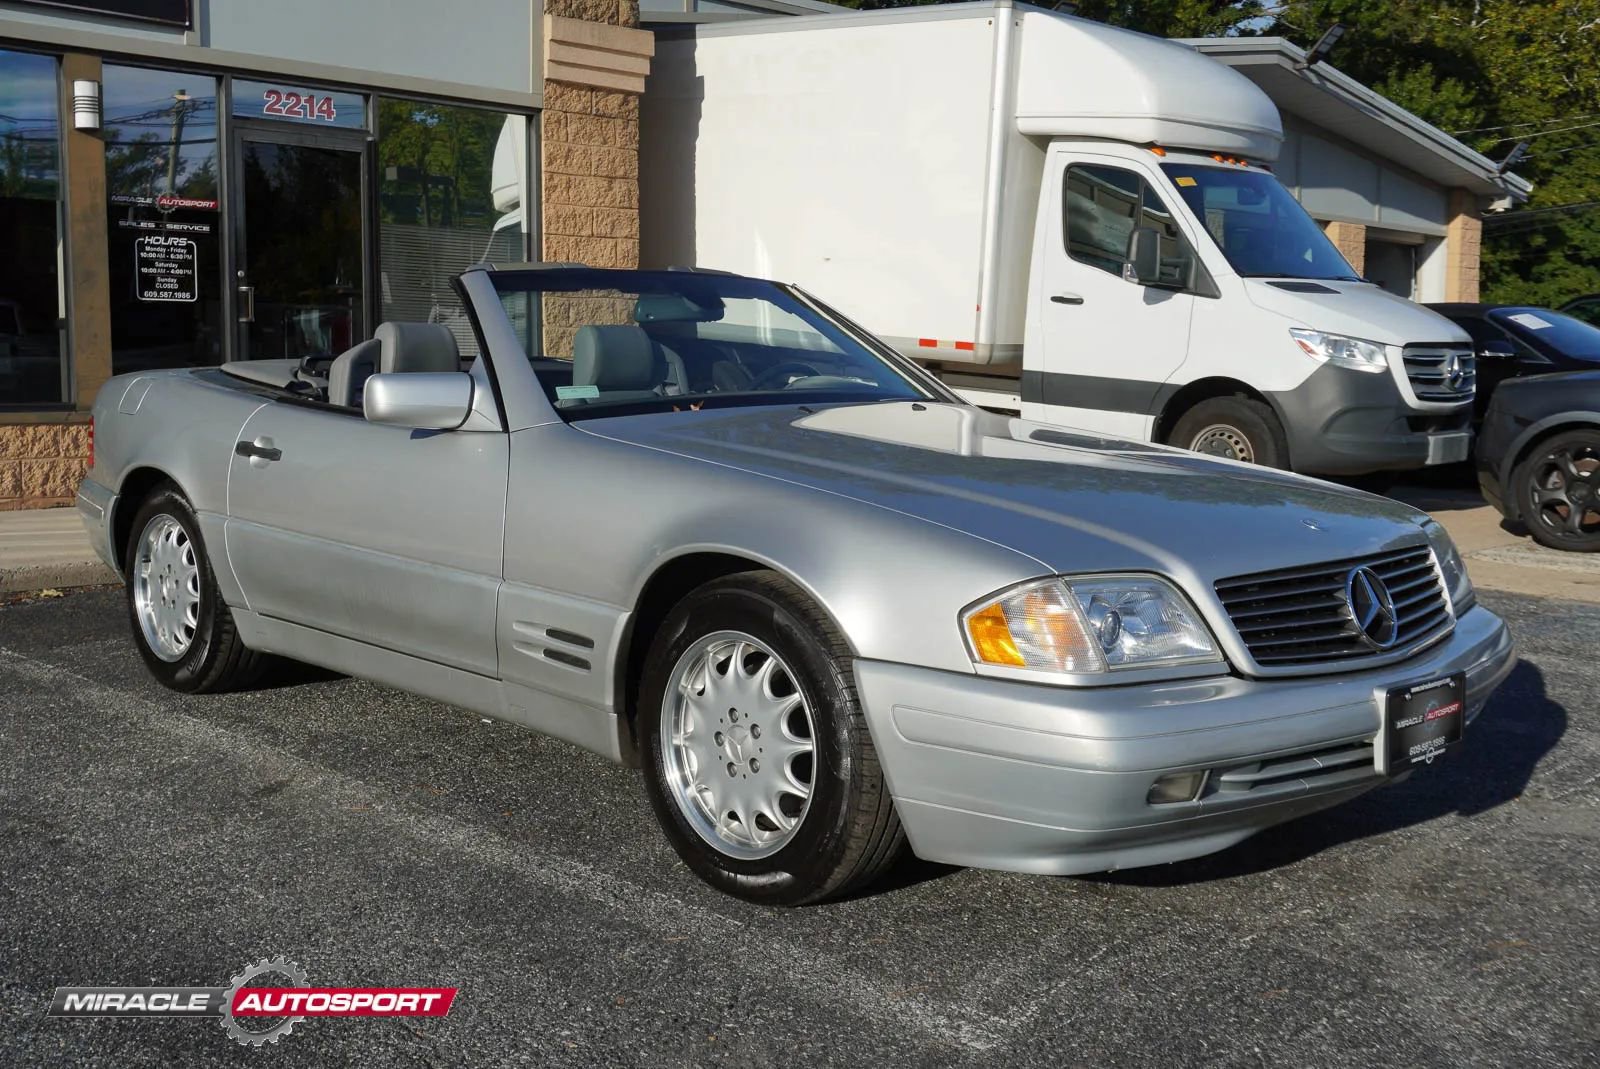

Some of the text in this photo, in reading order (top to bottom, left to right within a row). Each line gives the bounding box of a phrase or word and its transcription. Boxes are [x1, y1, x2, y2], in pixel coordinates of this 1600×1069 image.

[264, 89, 336, 121] 2214
[111, 195, 215, 208] MIRACLE AUTOSPORT
[119, 220, 210, 232] SALES SERVICE
[144, 236, 188, 246] HOURS
[144, 291, 190, 299] 609.587.1986
[1396, 703, 1459, 730] MIRACLE AUTOSPORT
